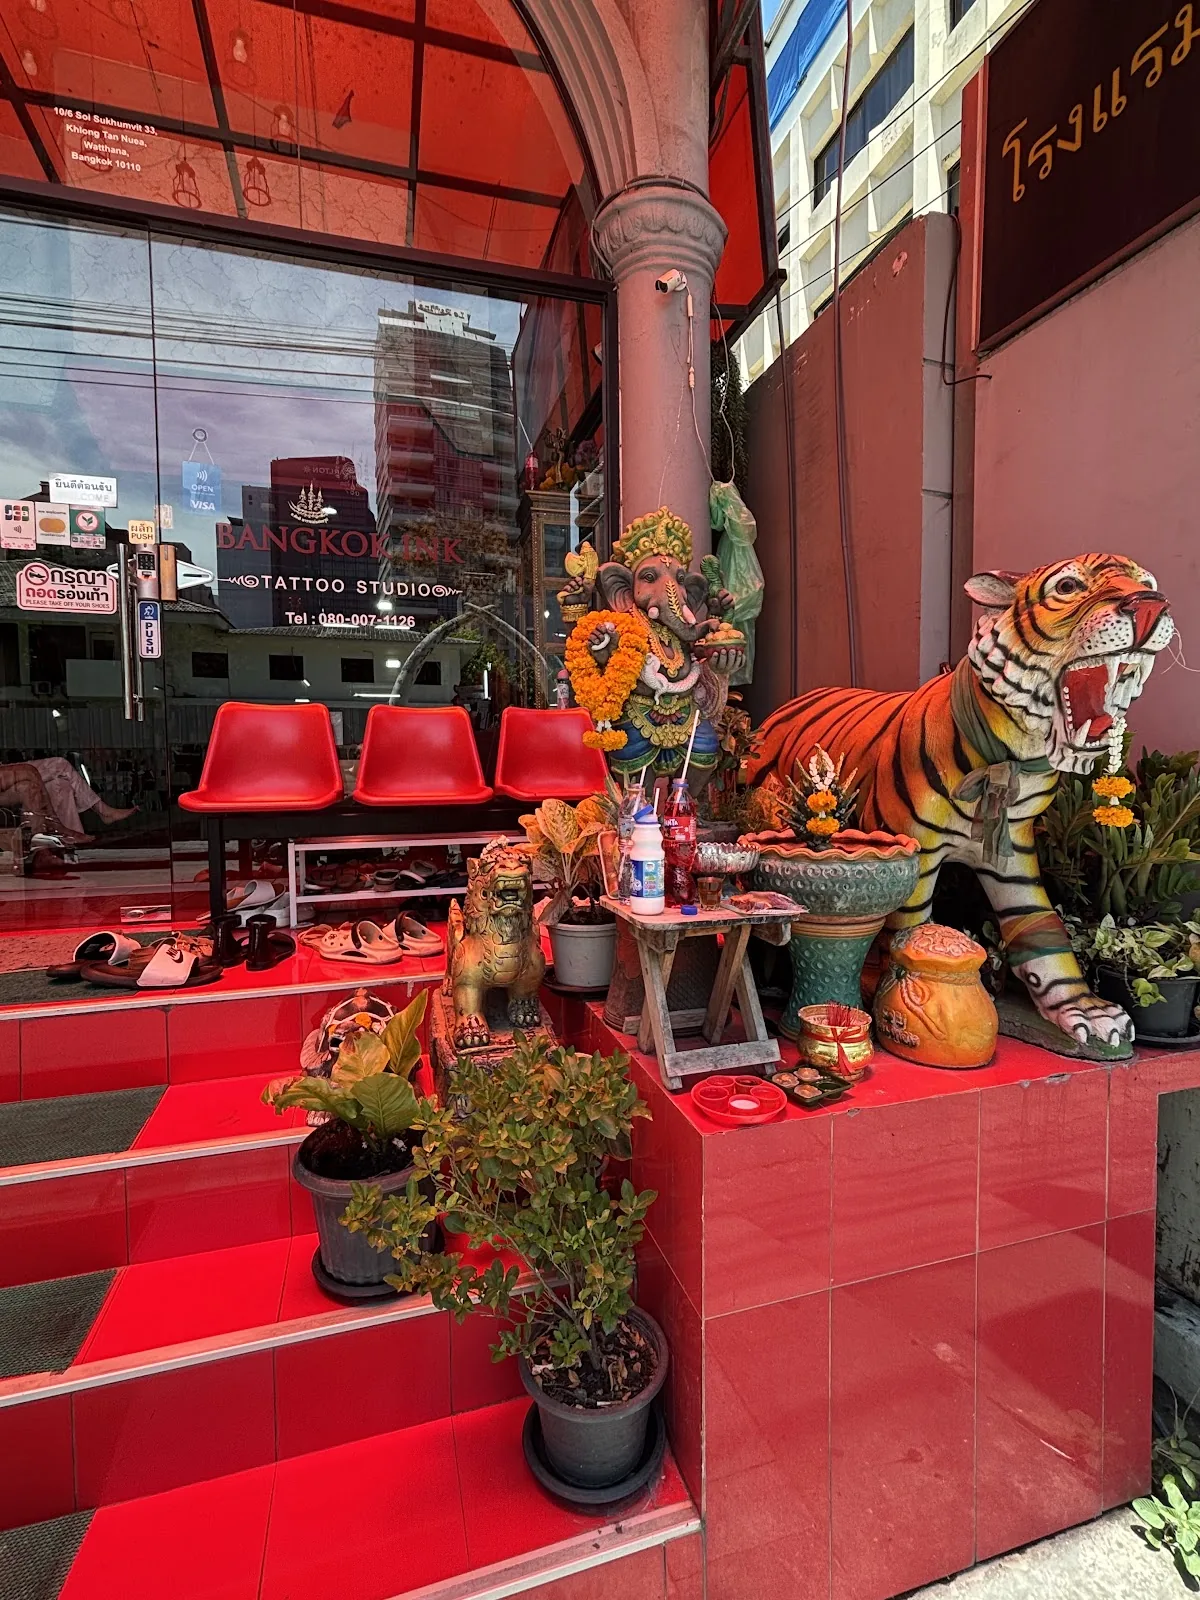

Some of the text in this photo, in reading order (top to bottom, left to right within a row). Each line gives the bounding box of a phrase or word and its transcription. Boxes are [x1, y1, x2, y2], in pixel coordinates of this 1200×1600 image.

[53, 106, 158, 136] 10/6 Soi Sukhumvit 33,
[65, 123, 148, 148] Khlong Tan Nuea,
[83, 140, 130, 157] Watthana,
[71, 151, 141, 172] Bangkok 10110
[55, 478, 112, 492] ยินดีต้อนรับ
[191, 483, 214, 493] OPEN
[4, 505, 30, 521] JCB
[190, 499, 216, 511] VISA
[130, 524, 154, 534] ผลัก
[216, 522, 464, 563] BANGKOK INK
[50, 569, 108, 590] กรุณา
[260, 575, 430, 597] TATTOO STUDIO
[25, 587, 109, 602] ถอดรองเท้า
[318, 612, 416, 628] 080-007-1126
[145, 622, 153, 654] PUSH
